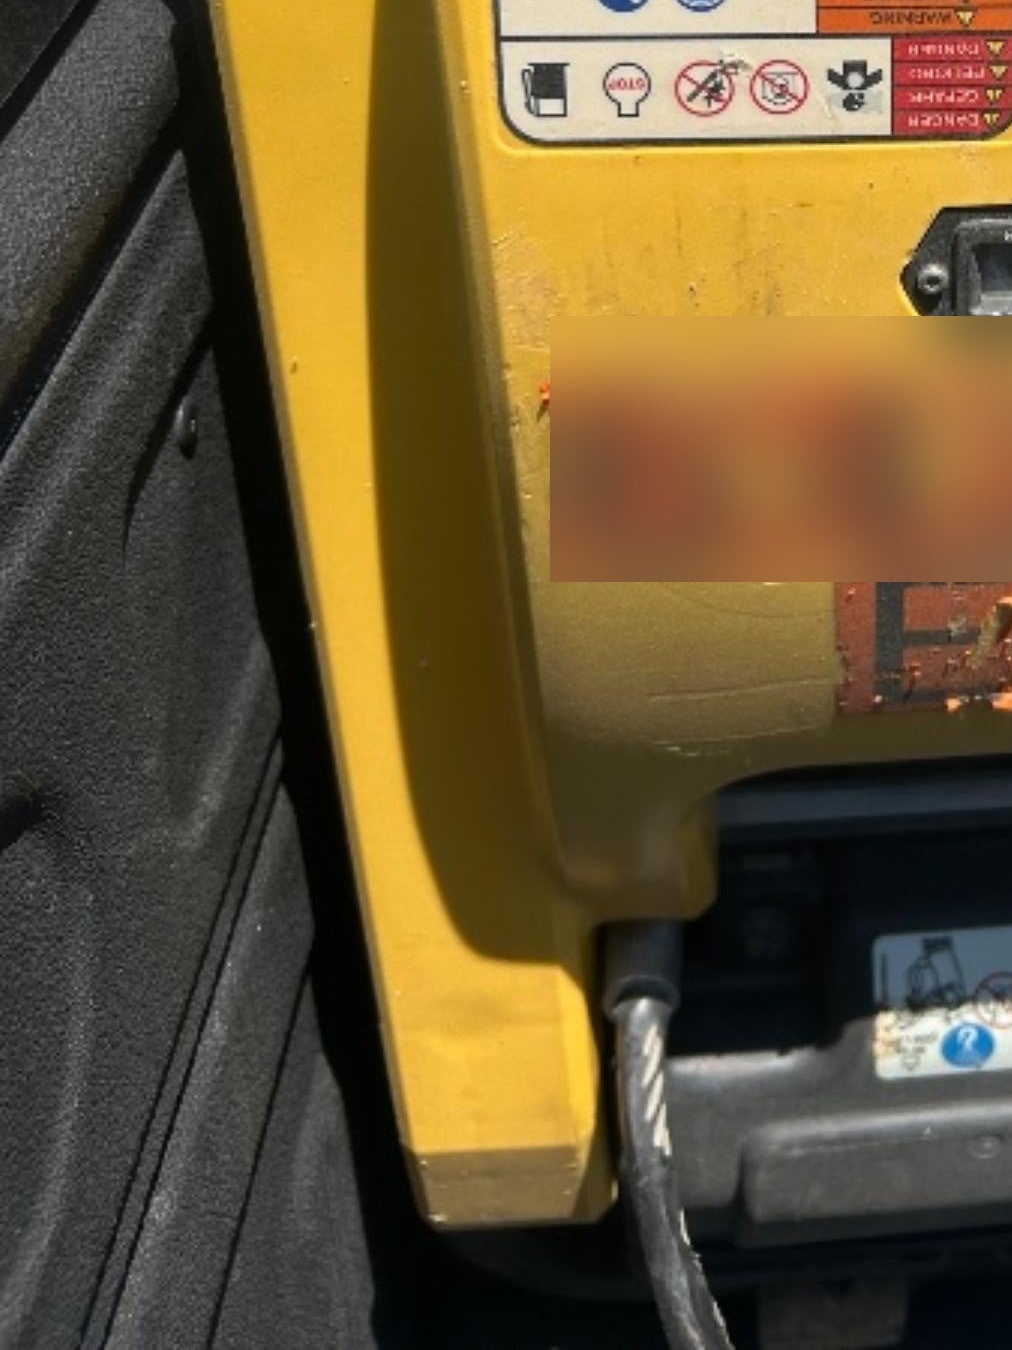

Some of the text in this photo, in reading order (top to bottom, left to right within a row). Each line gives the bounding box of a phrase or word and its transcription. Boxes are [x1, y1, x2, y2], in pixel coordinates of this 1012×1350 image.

[869, 10, 952, 26] WARNING
[608, 78, 646, 91] STOP
[907, 88, 980, 105] GEFAHR
[907, 112, 981, 128] DANGER
